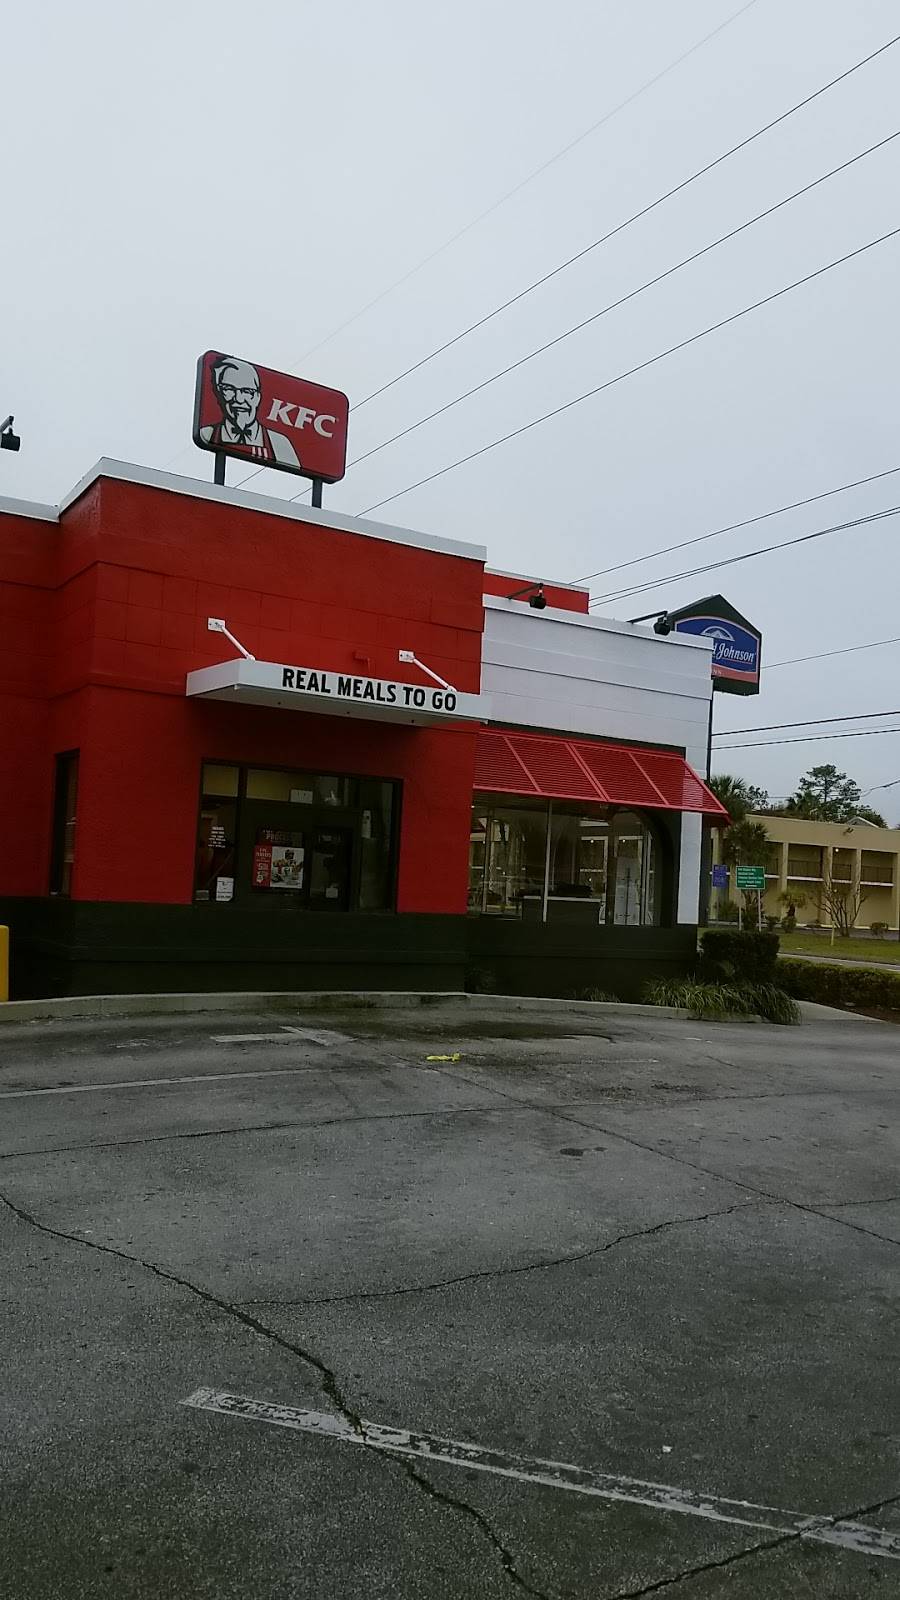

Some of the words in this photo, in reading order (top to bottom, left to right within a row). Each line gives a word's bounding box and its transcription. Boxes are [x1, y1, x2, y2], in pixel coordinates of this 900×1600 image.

[266, 398, 337, 438] KFC
[716, 642, 754, 663] Johnson
[282, 668, 331, 693] REAL
[337, 676, 396, 703] MEALS
[402, 687, 426, 707] TO
[432, 692, 457, 711] GO
